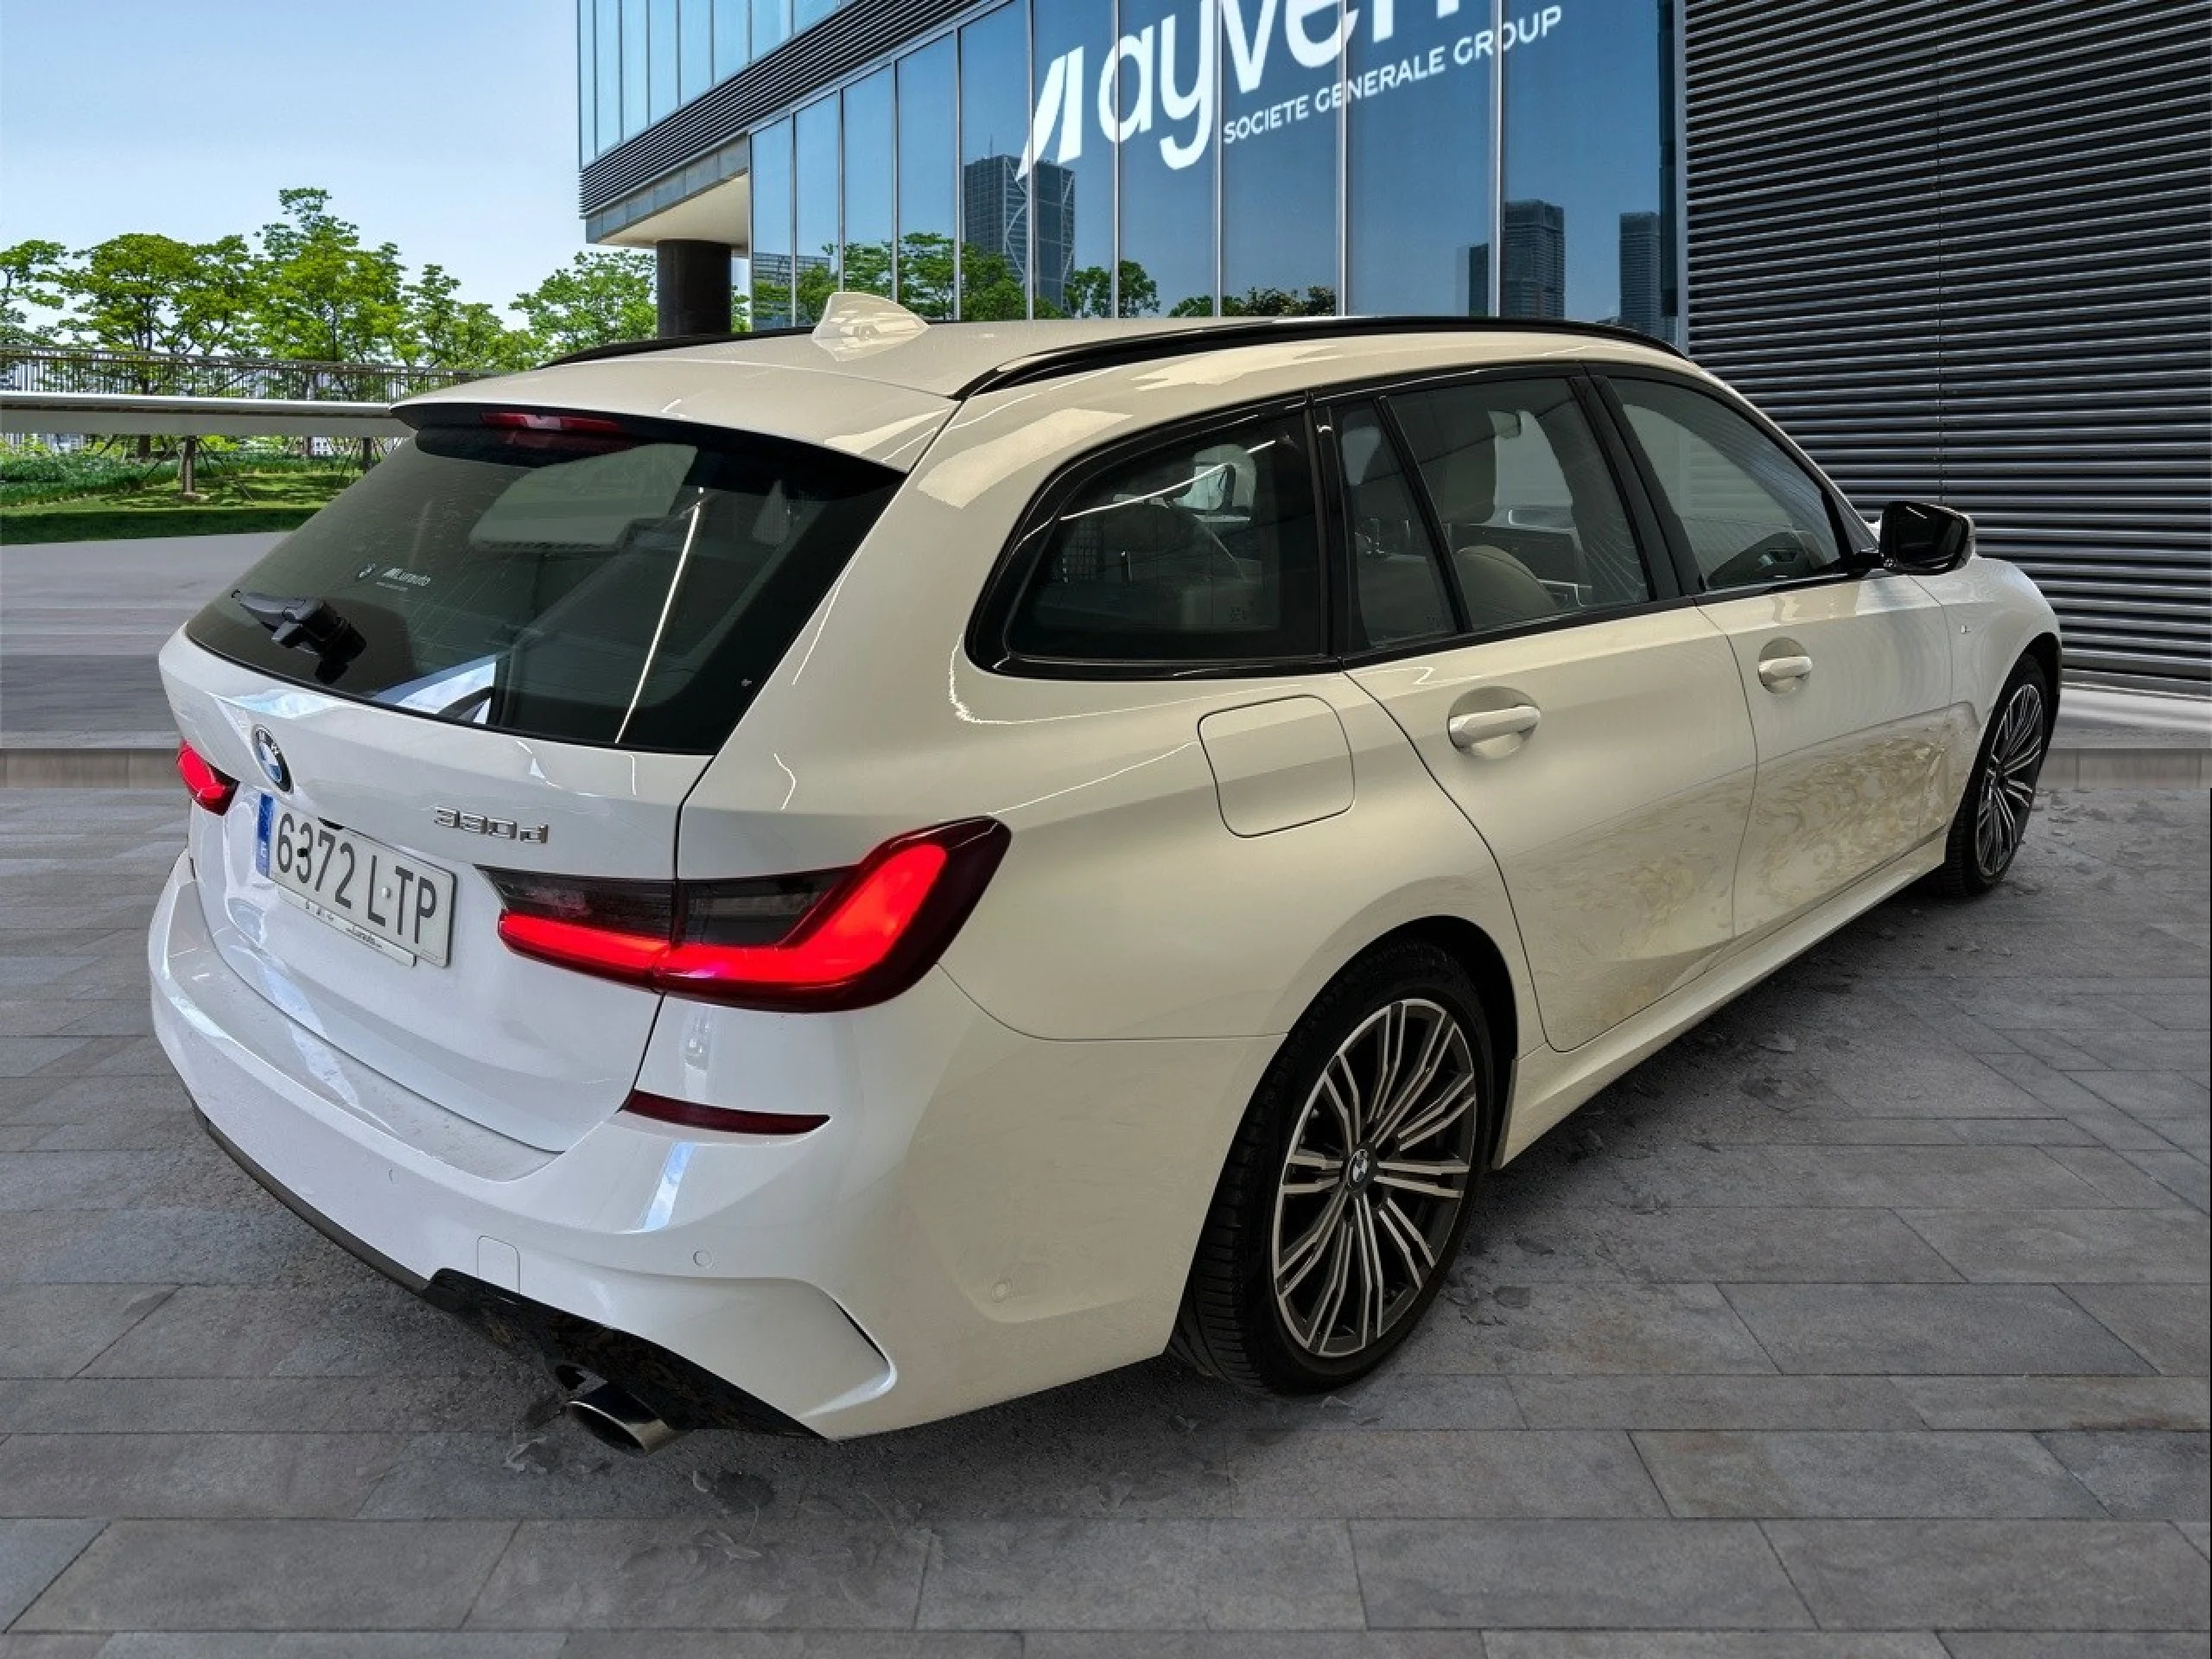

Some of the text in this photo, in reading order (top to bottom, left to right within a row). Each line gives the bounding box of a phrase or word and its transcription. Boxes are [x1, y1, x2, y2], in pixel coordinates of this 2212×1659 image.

[1097, 0, 1461, 170] ayve
[1224, 4, 1562, 144] SOCIETE GENERALE GROUP
[276, 812, 437, 944] 6372 LTP
